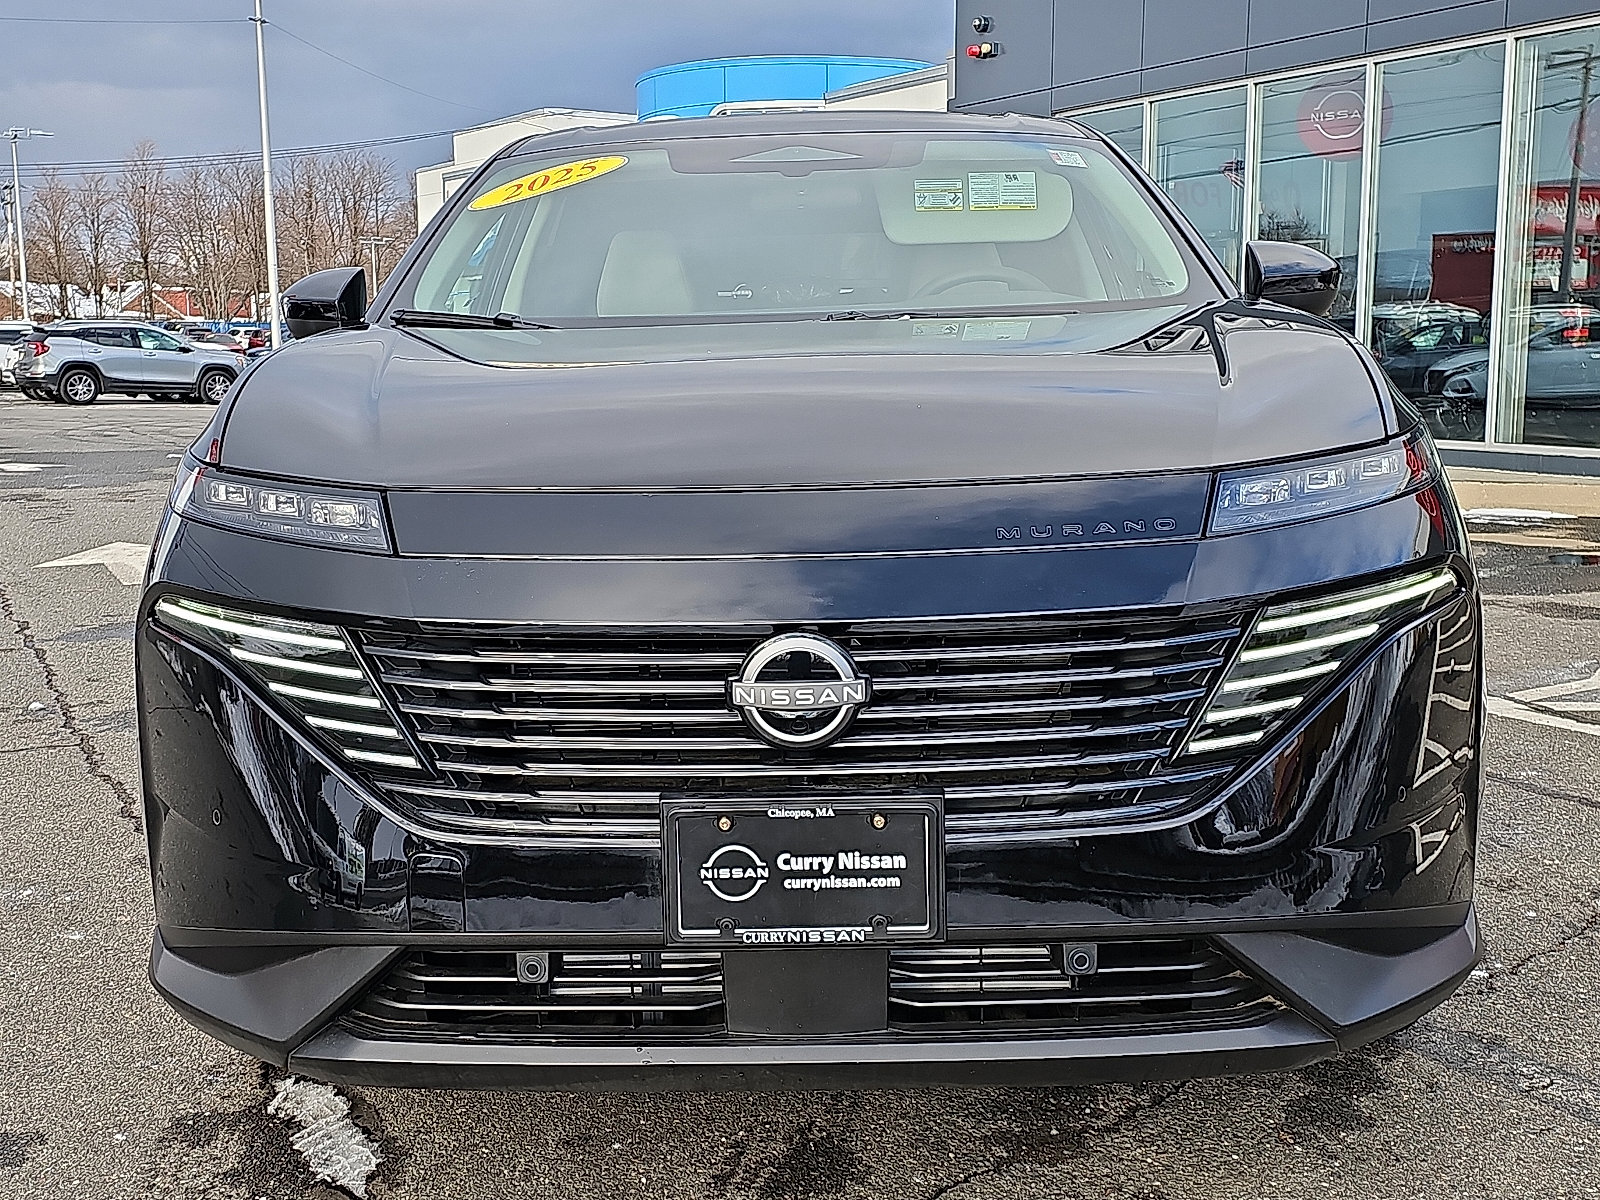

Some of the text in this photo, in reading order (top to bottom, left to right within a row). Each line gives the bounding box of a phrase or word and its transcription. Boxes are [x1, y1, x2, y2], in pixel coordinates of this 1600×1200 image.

[1310, 109, 1363, 122] NISSA
[501, 160, 599, 202] 2025
[996, 518, 1176, 539] MURANO
[735, 684, 863, 706] NISSAN
[767, 806, 835, 819] Chicopee, MA
[776, 851, 907, 874] Curry Nissan
[700, 867, 769, 879] NISSAN
[783, 875, 901, 891] currynissan.com
